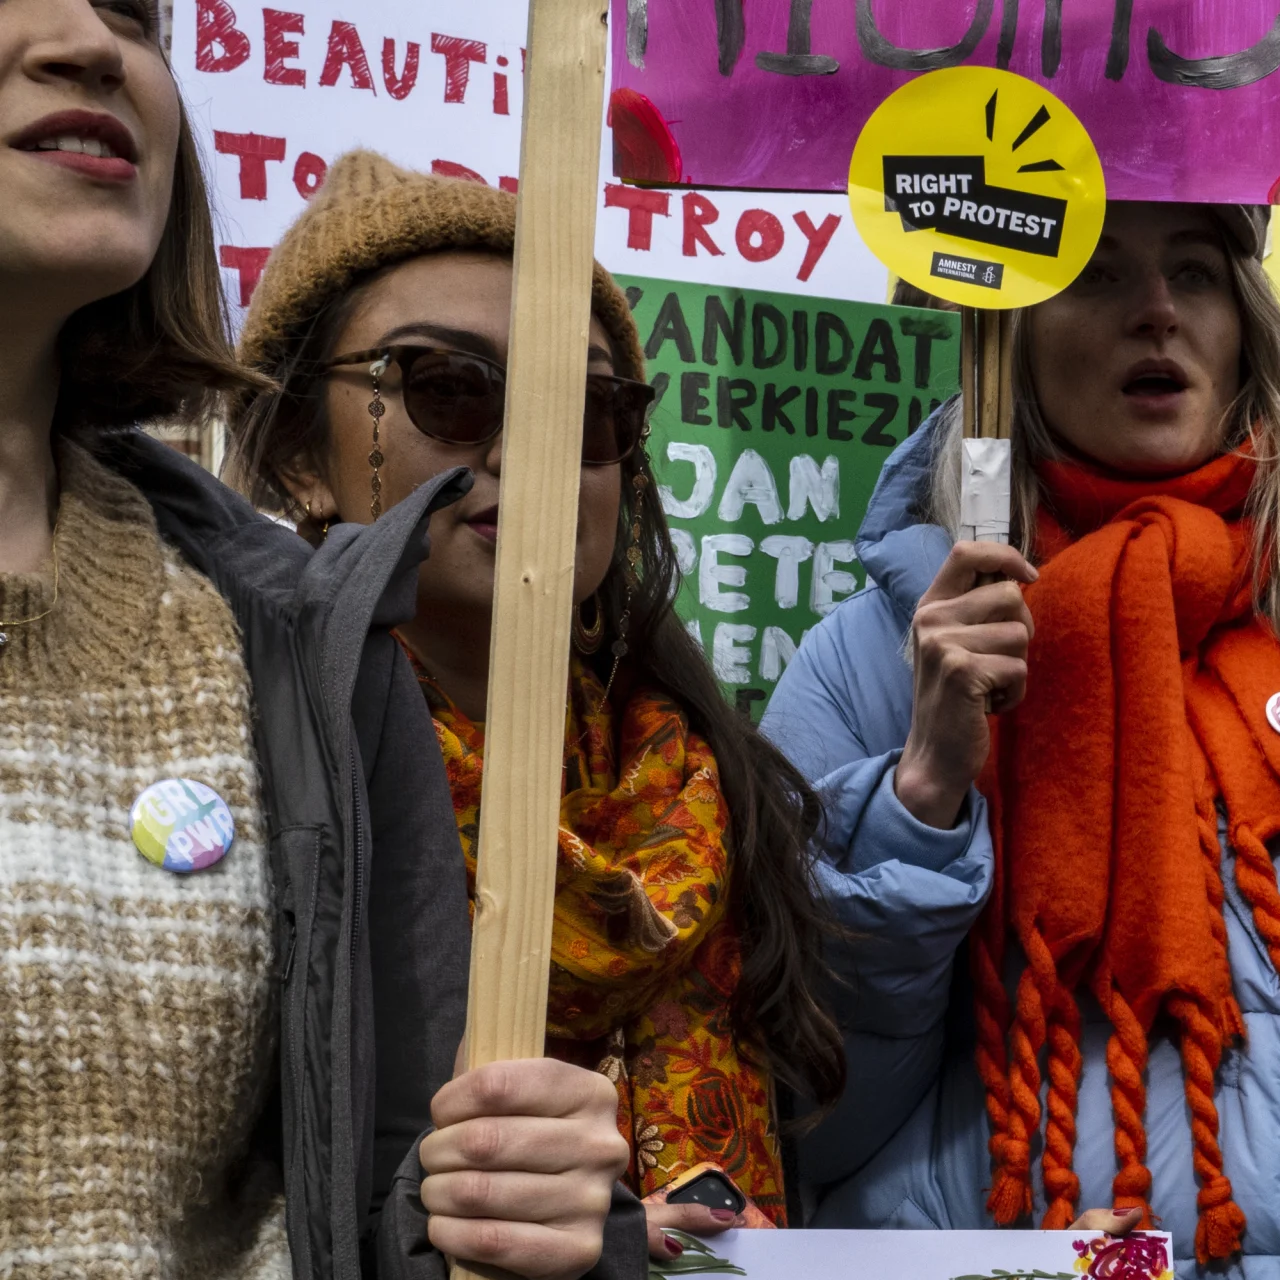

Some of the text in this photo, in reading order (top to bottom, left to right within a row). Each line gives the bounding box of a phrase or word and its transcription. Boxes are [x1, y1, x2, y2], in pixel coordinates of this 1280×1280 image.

[195, 0, 527, 115] BEAUTi
[896, 174, 972, 194] RIGHT
[909, 197, 1056, 238] TO PROTEST
[937, 267, 975, 280] INTERNATIONAL
[938, 258, 977, 273] AMNESTY
[625, 286, 954, 390] ANDIDAT
[657, 442, 841, 525] JAN
